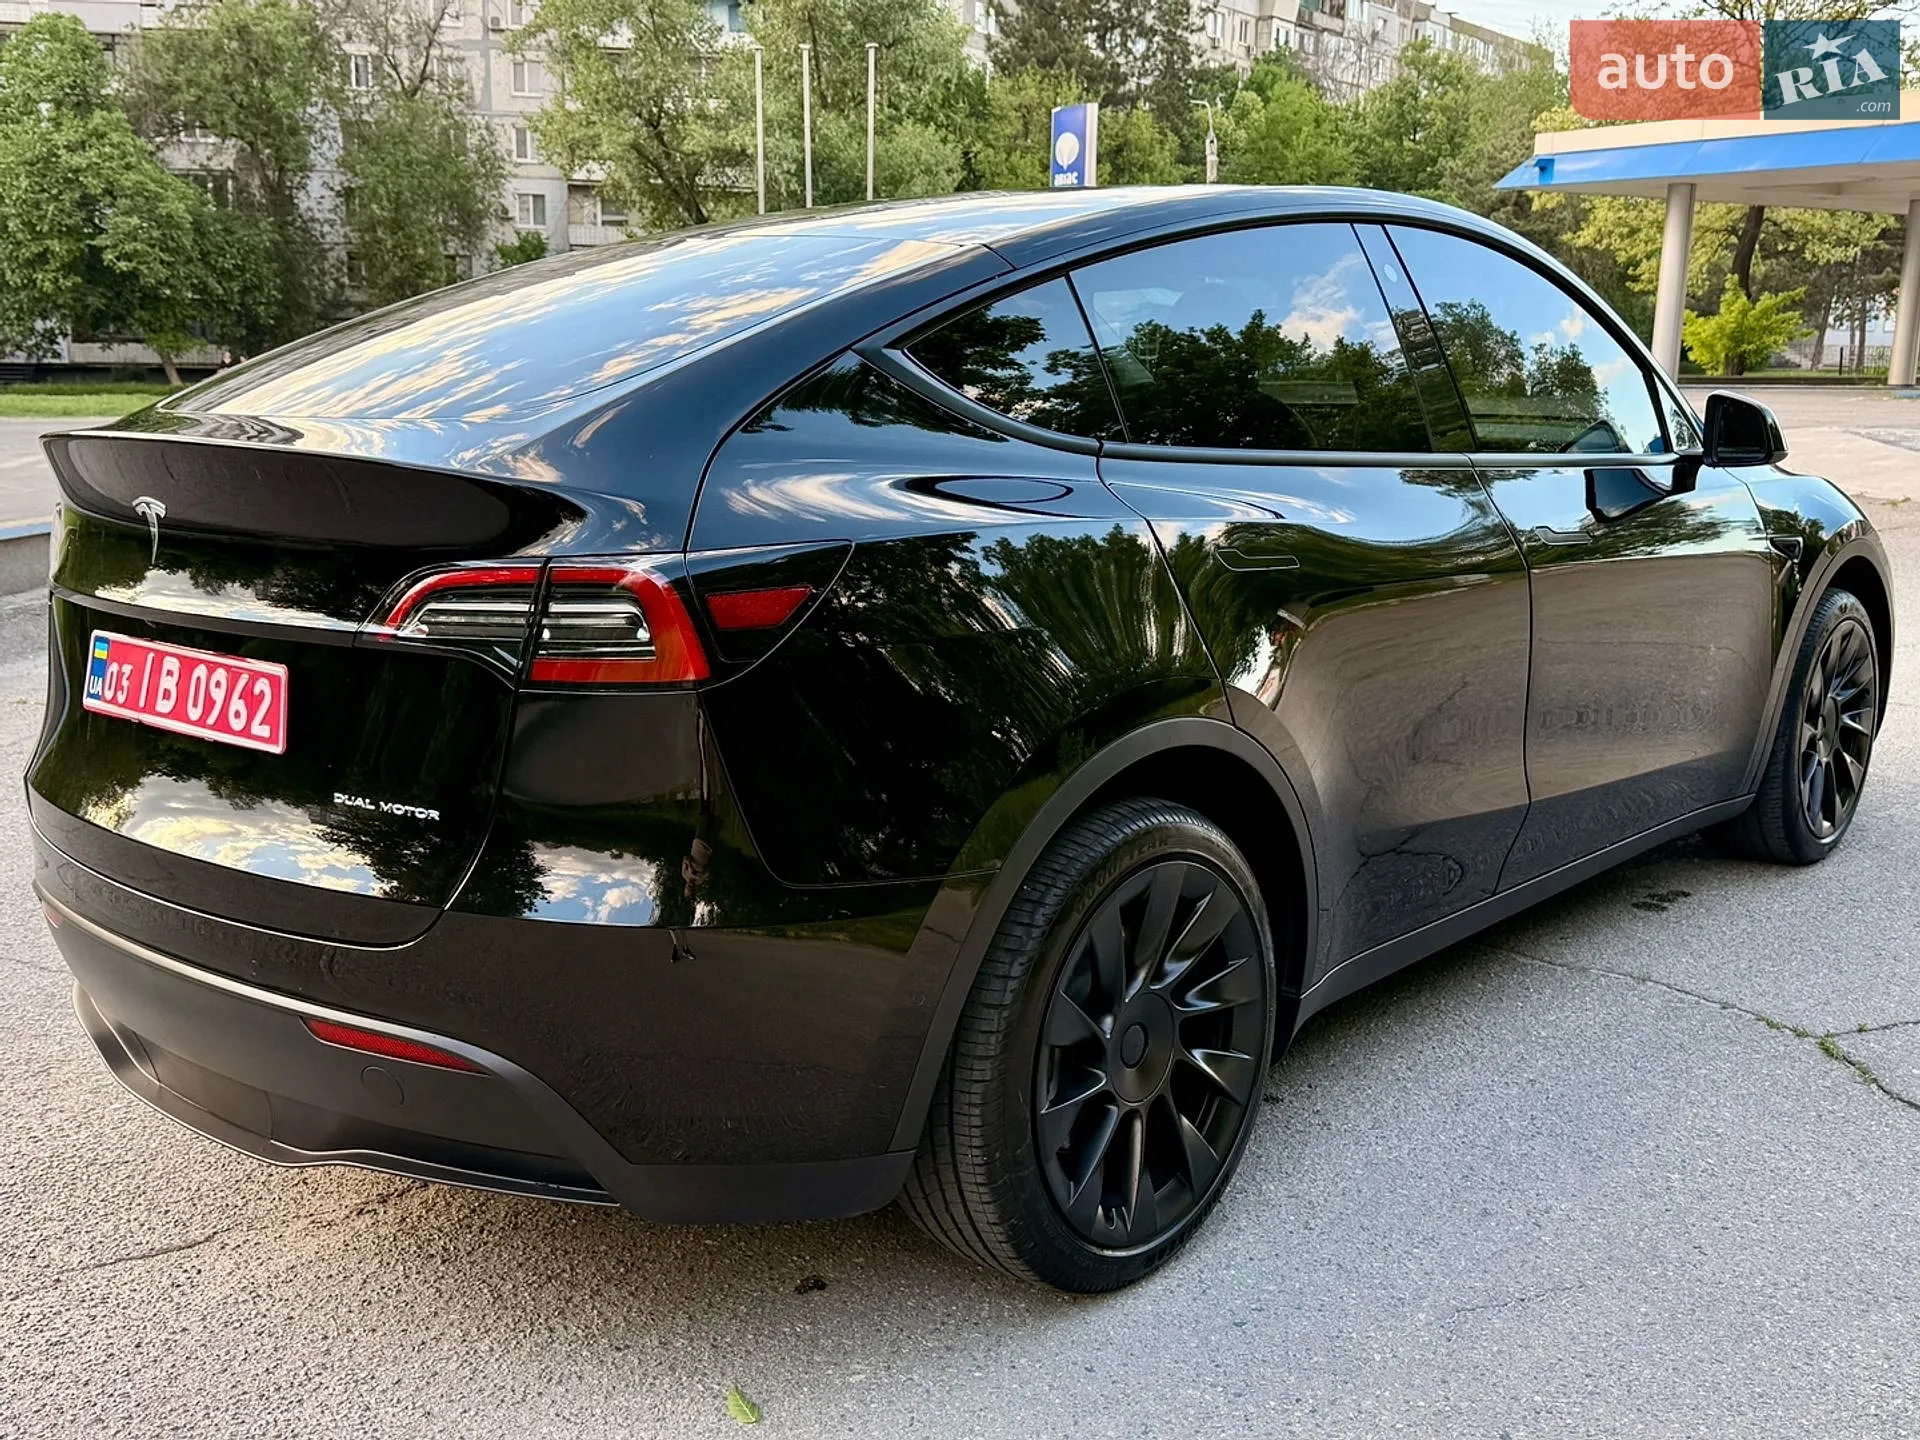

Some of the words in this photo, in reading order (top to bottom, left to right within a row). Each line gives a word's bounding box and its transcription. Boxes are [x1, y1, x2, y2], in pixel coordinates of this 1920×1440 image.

[89, 674, 103, 696] UA
[103, 661, 134, 705] 03
[186, 662, 272, 739] 0962
[333, 792, 376, 810] DUAL
[379, 801, 440, 821] MOTOR
